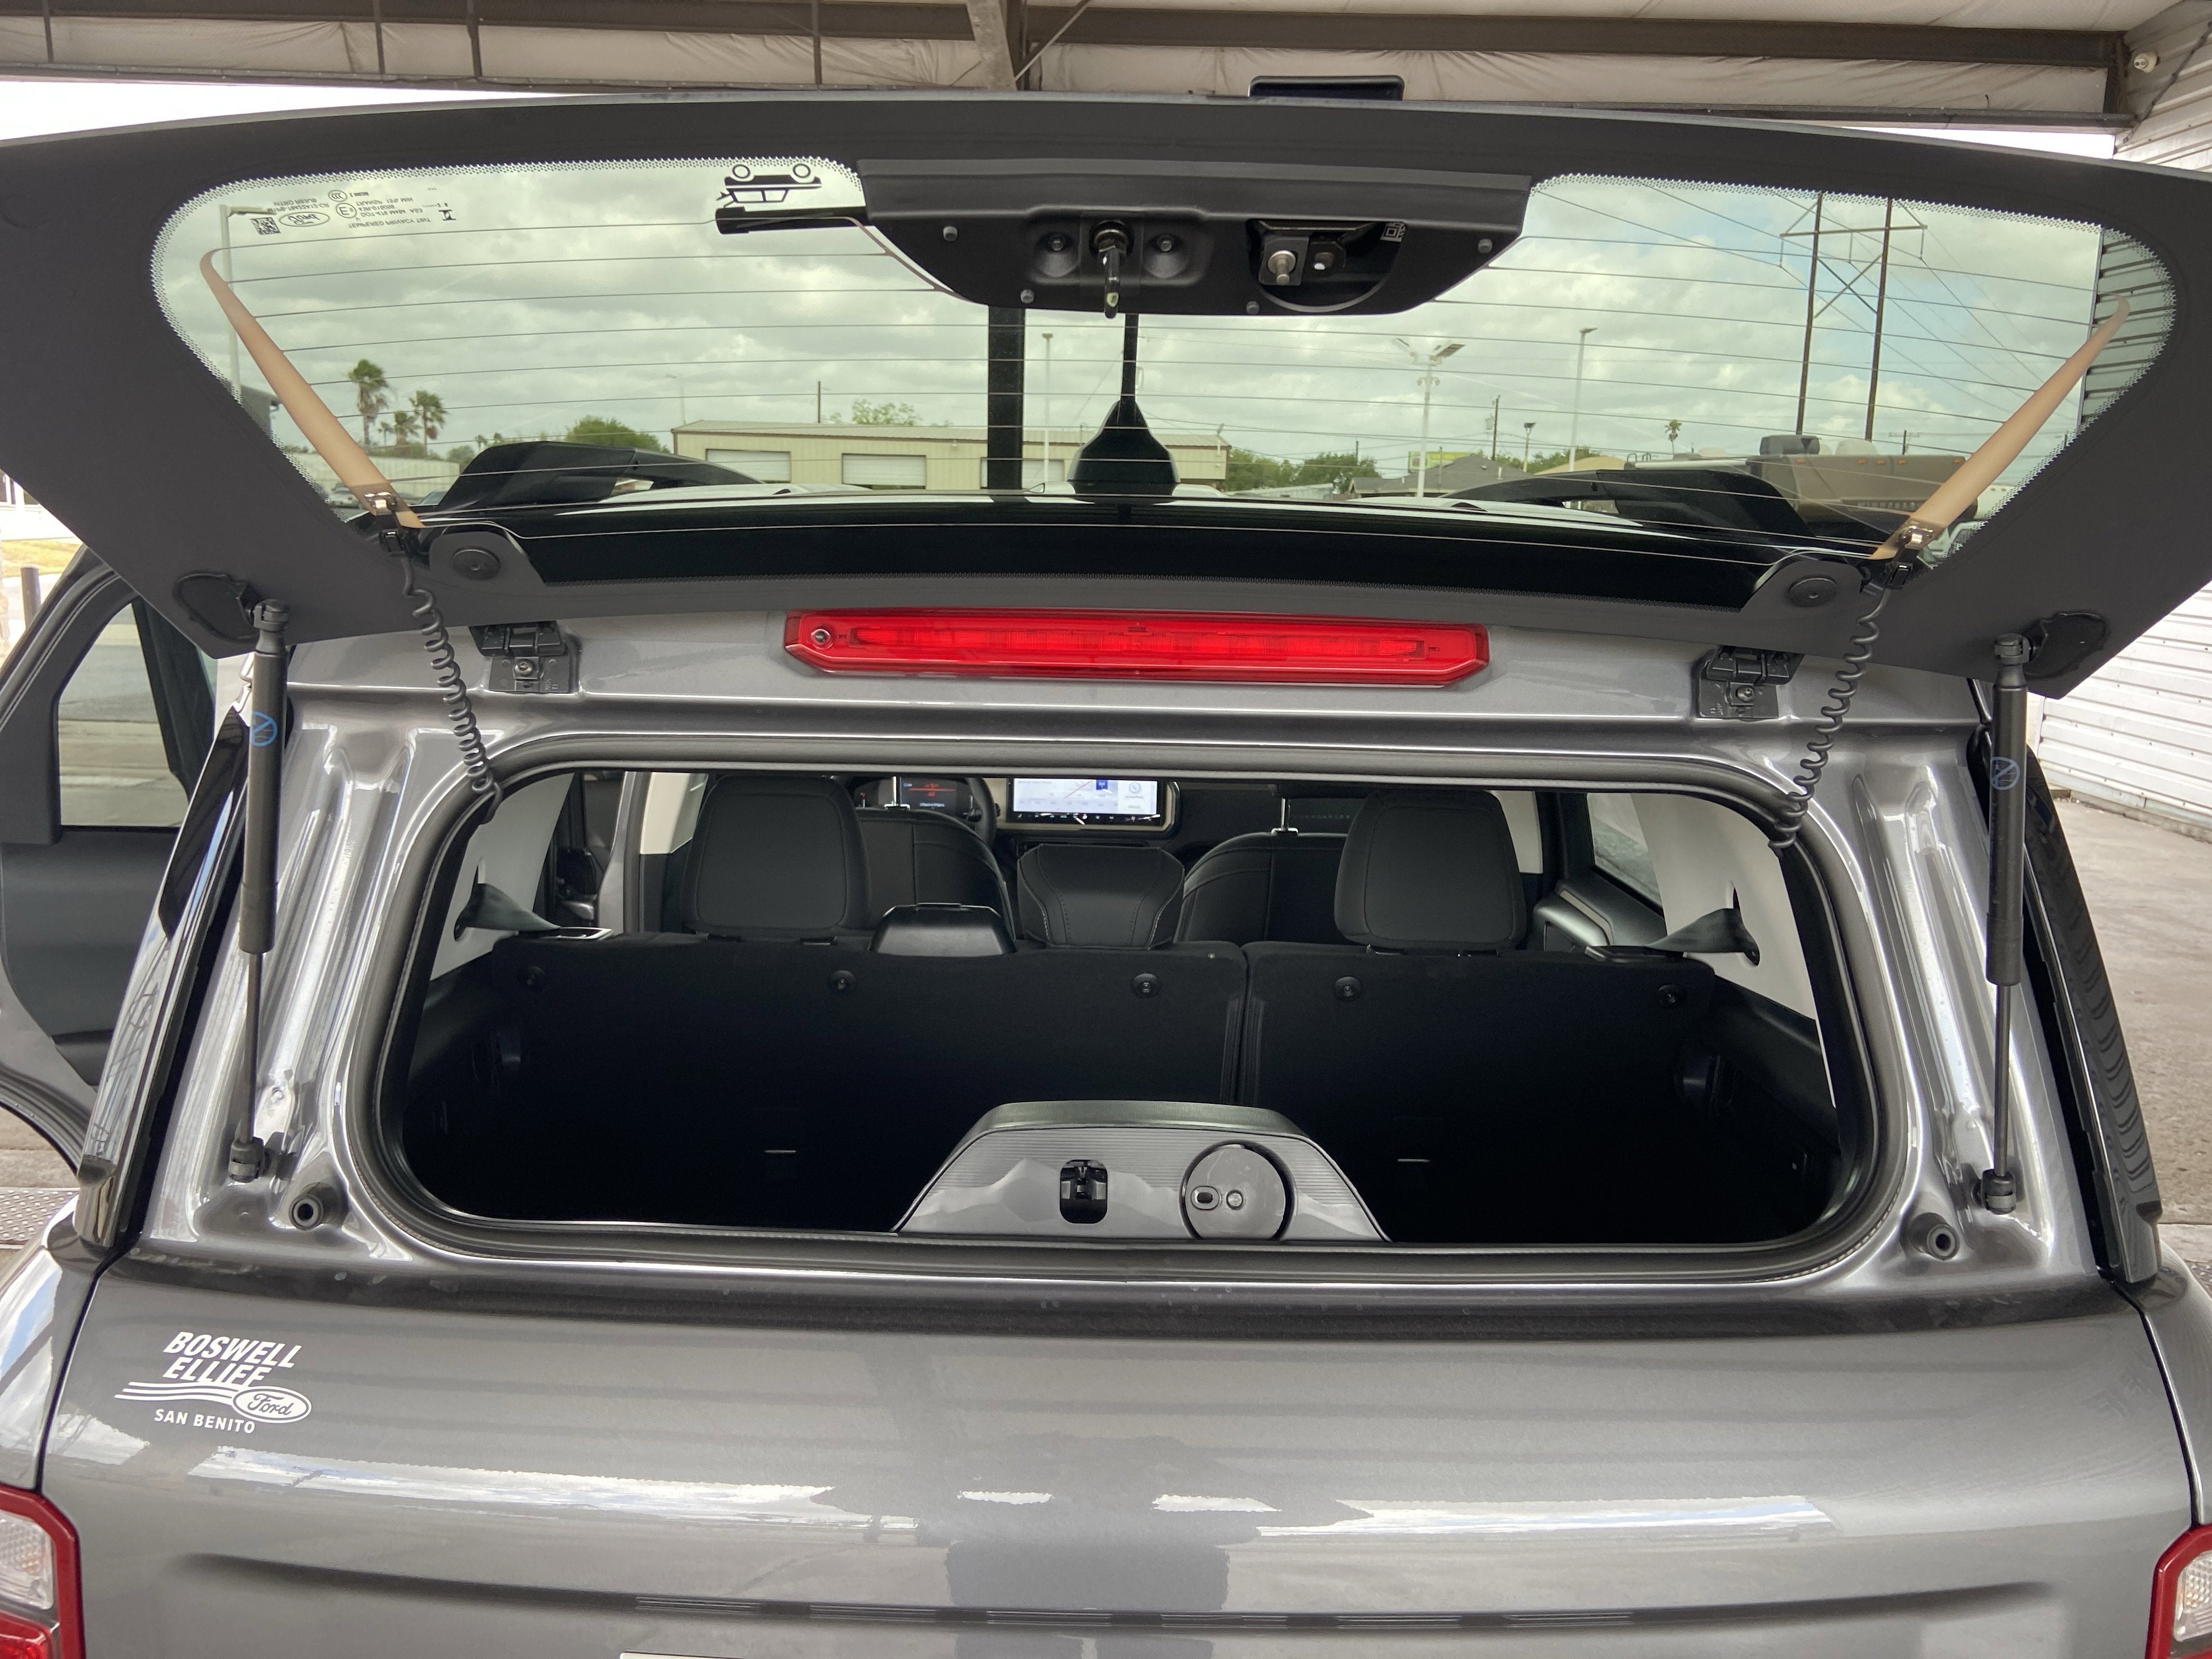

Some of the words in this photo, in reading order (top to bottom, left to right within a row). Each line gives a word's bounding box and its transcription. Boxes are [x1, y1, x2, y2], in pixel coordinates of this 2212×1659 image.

[163, 1331, 302, 1368] BOSWELL
[162, 1357, 272, 1386] ELLIFF
[247, 1393, 294, 1415] Ford
[154, 1409, 188, 1425] SAN
[194, 1414, 255, 1434] BENITO
